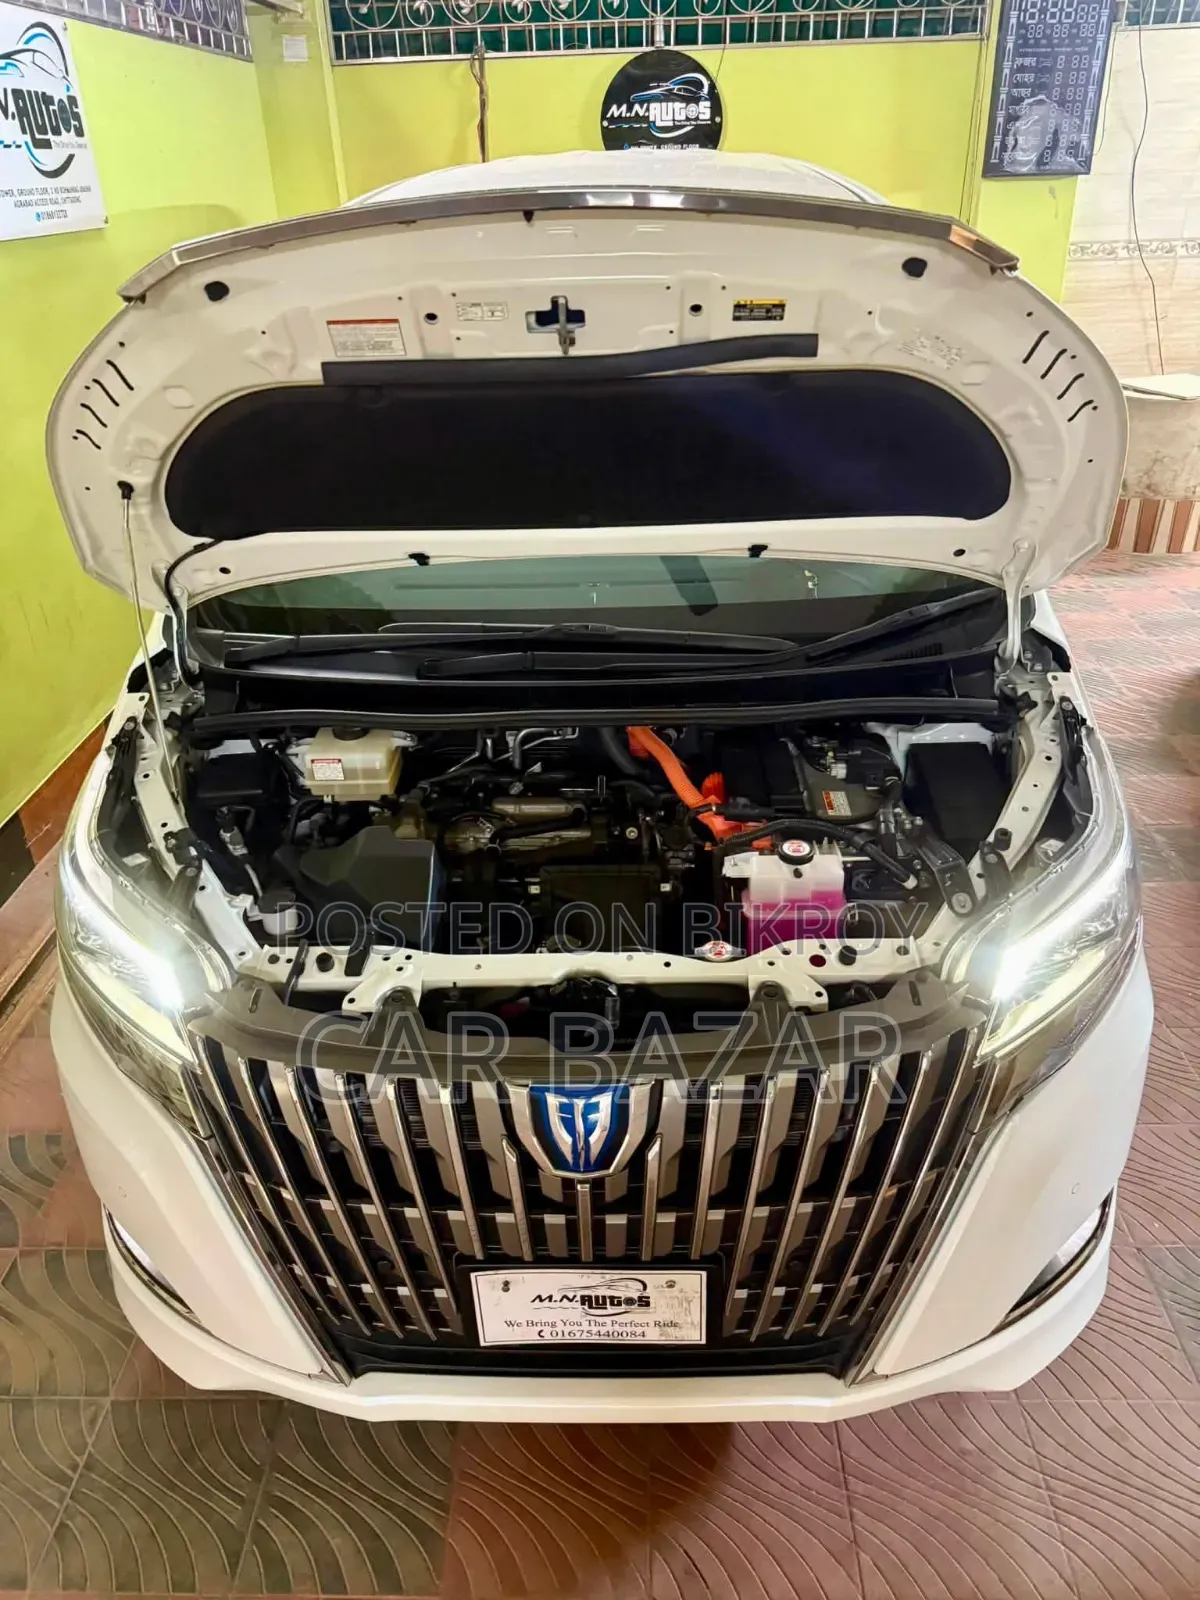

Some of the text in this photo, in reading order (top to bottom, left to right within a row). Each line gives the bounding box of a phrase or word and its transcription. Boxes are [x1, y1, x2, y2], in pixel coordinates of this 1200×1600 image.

[504, 1319, 523, 1328] We
[526, 1319, 557, 1329] Bring
[561, 1318, 582, 1328] You
[585, 1318, 608, 1328] The
[611, 1319, 650, 1328] Perfect
[549, 1329, 646, 1339] 01675440084
